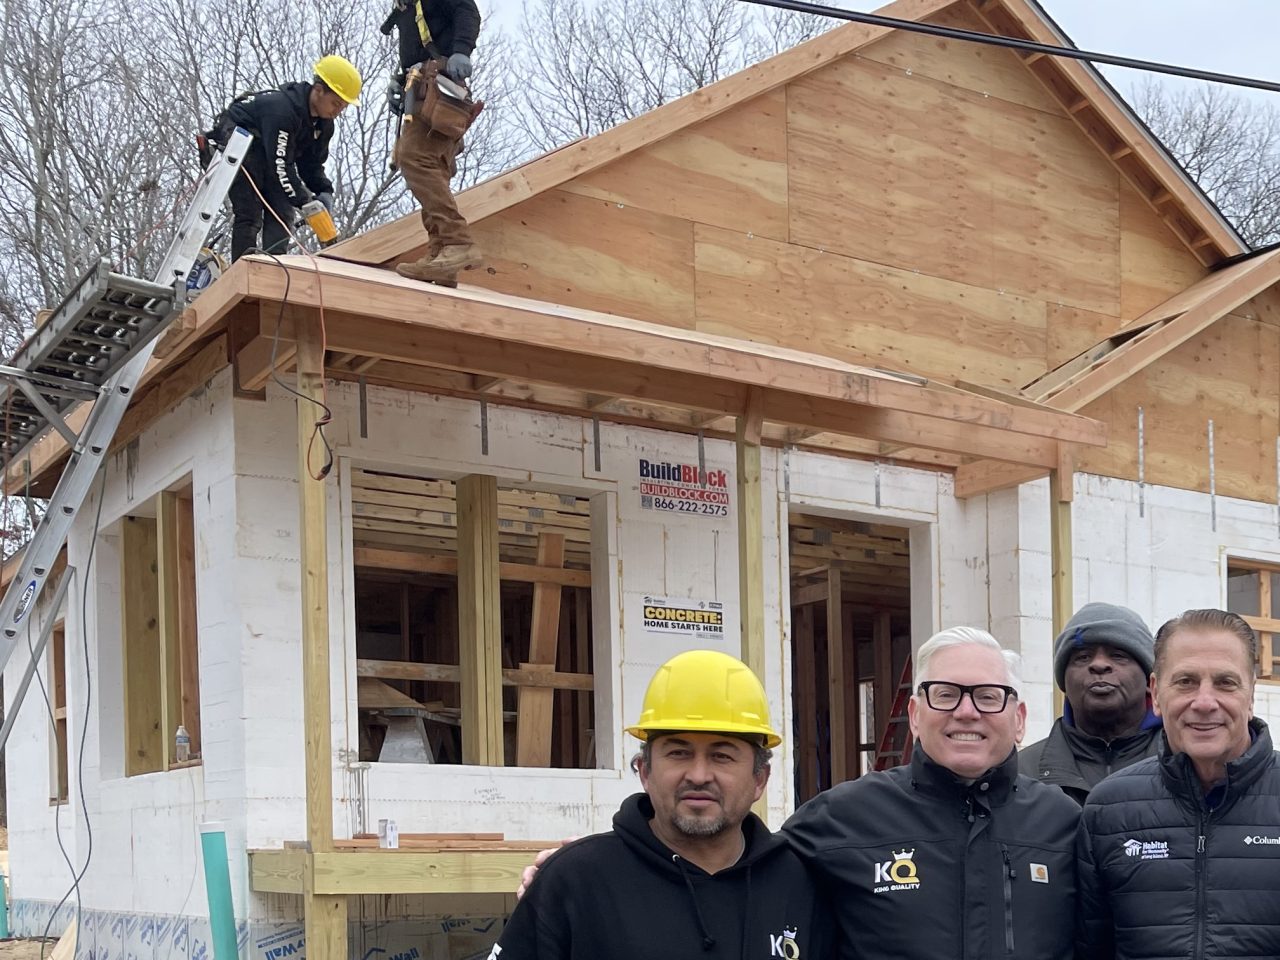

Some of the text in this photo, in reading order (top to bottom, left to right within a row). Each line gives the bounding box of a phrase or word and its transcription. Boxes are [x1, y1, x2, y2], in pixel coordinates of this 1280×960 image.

[275, 130, 296, 198] KING QUALITY
[640, 483, 729, 504] BUILDBLOCK.COM
[654, 498, 728, 516] 866-222-2575
[645, 606, 722, 625] CONCRETE:
[644, 620, 723, 633] HOME STARTS HERE
[1142, 841, 1168, 849] Habitat
[874, 859, 920, 883] KQ
[890, 883, 920, 891] QUALITY
